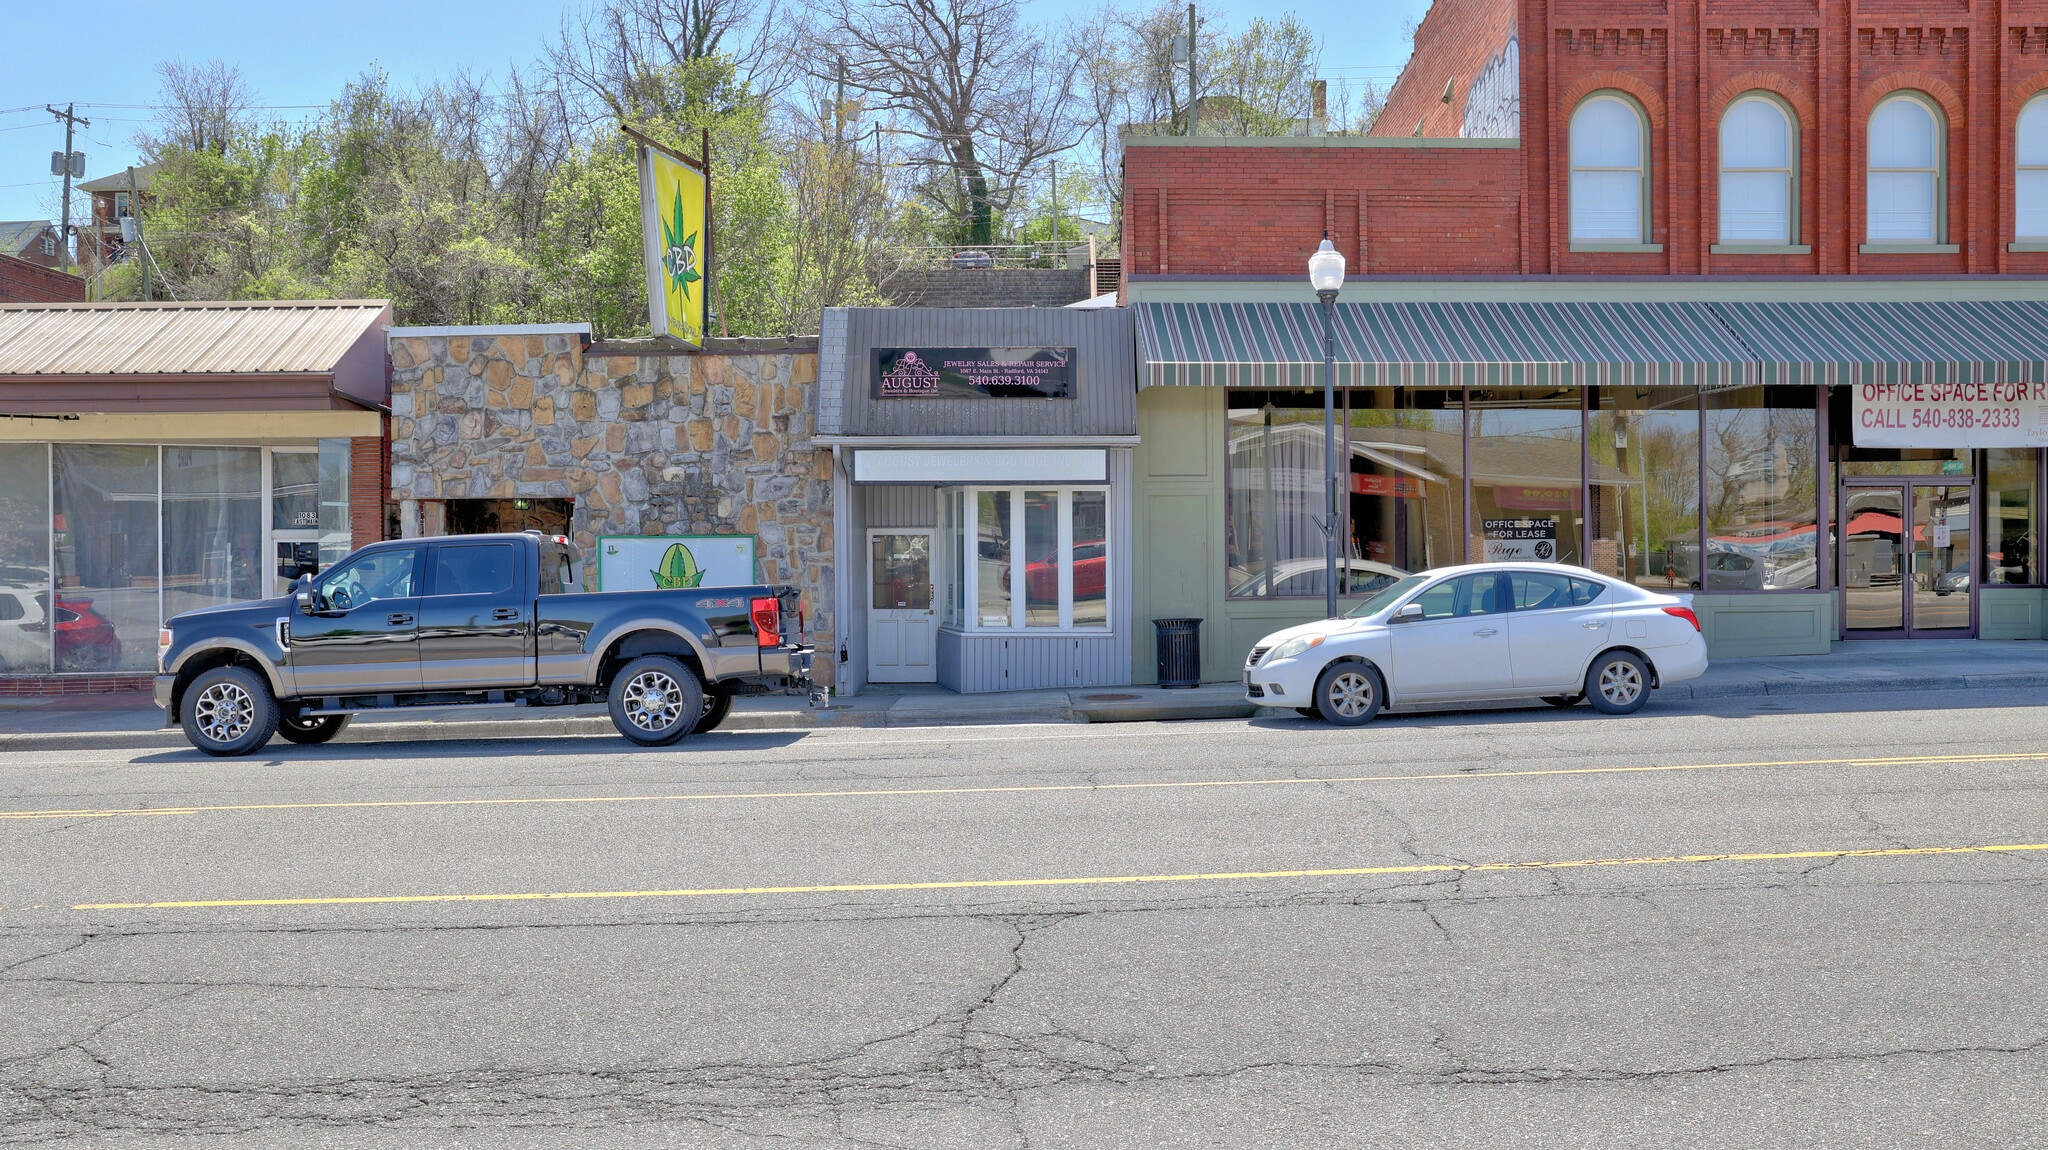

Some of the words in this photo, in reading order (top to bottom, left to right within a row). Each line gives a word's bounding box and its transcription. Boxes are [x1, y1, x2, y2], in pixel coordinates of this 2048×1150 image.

[666, 245, 697, 278] CBD
[881, 378, 940, 389] AUGUST
[969, 376, 1040, 386] 540.639.3100
[1862, 384, 1925, 402] OFFICE
[1930, 384, 1989, 402] SPACE
[1993, 383, 2028, 402] FOR
[1861, 408, 1906, 428] CALL
[1912, 408, 2020, 428] 540-838-2333
[877, 455, 921, 467] AUGUST
[924, 455, 980, 467] JEWELERS
[983, 455, 991, 467] &
[995, 455, 1049, 467] BOUTIQUE
[1485, 520, 1520, 528] OFFICE
[1522, 520, 1554, 528] SPACE
[1493, 530, 1513, 538] FOR
[1516, 530, 1546, 538] LEASE
[1488, 541, 1522, 560] Page
[662, 576, 693, 588] CBD
